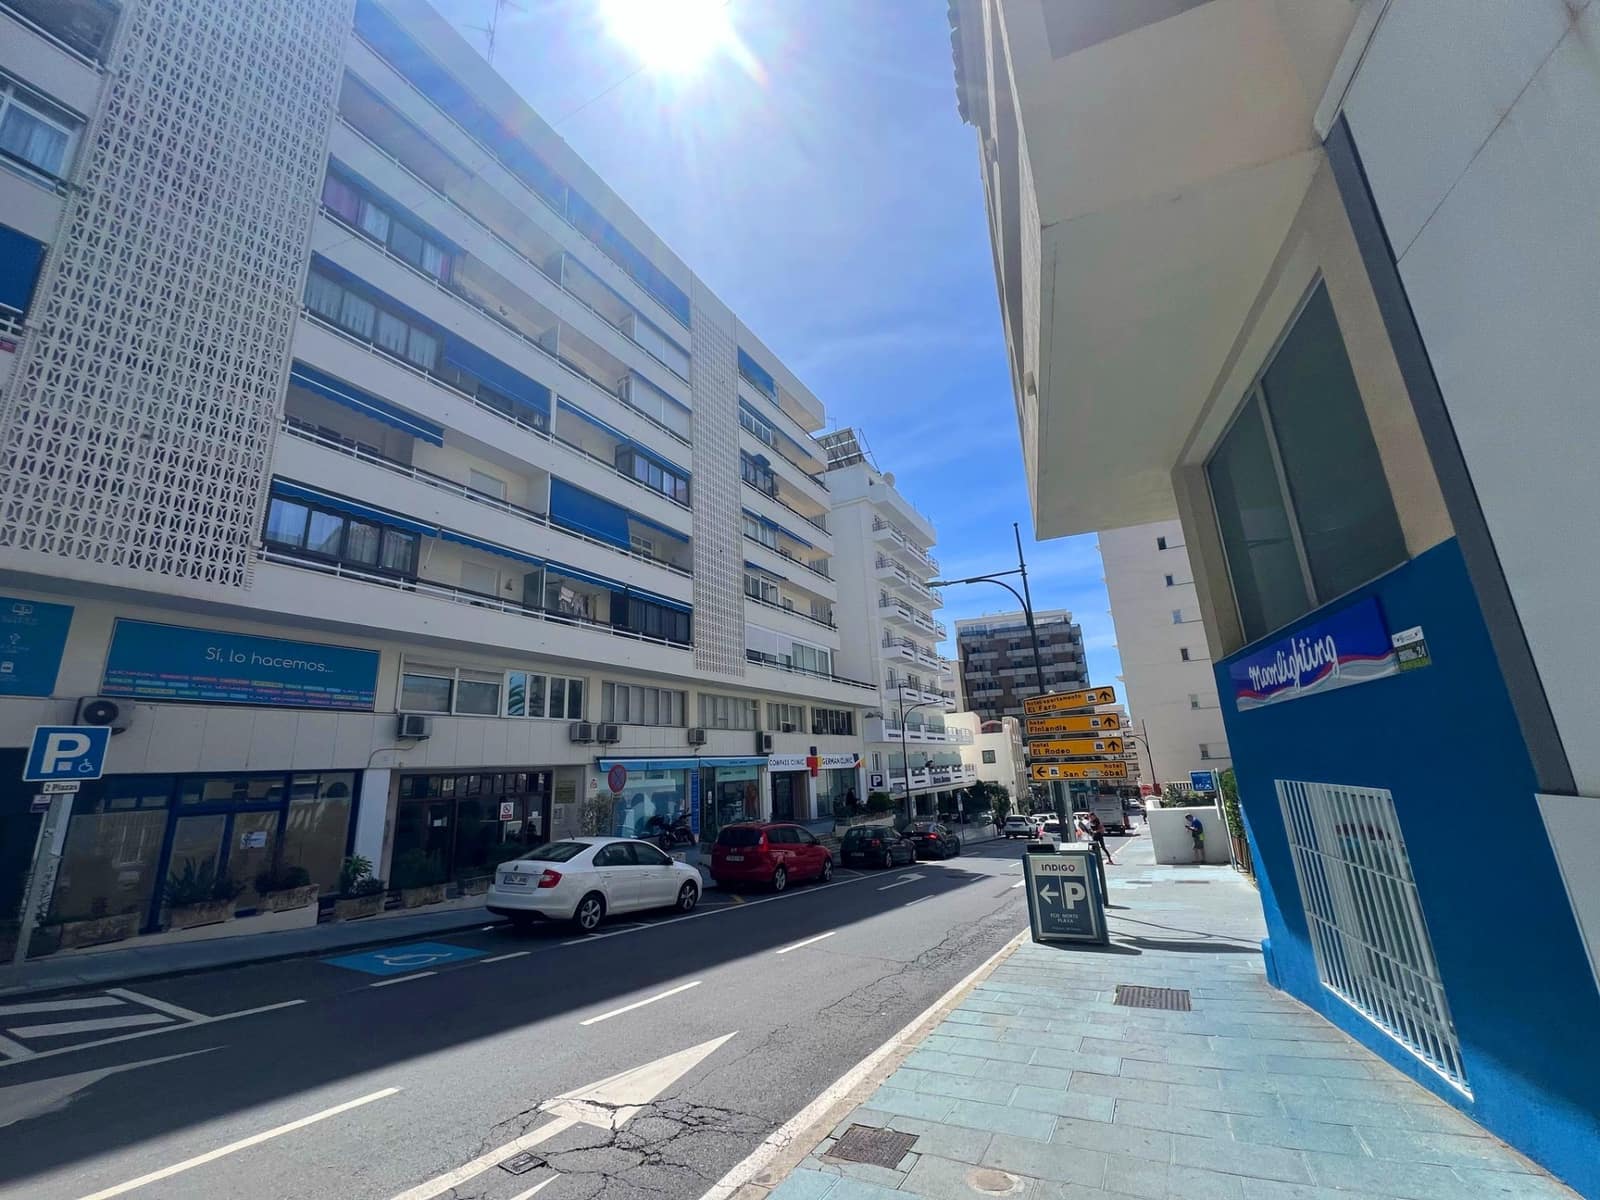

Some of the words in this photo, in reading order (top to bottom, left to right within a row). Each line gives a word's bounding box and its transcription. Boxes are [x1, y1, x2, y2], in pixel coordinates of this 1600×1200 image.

[205, 646, 225, 664] Sí,
[229, 648, 246, 664] lo
[1248, 634, 1339, 693] Moonlighting
[1039, 704, 1057, 712] Faro
[40, 733, 91, 774] P
[823, 756, 840, 764] GERMAN
[1083, 769, 1123, 777] Cóbal
[874, 776, 882, 785] P
[1041, 863, 1076, 872] INDIGO
[1064, 882, 1086, 909] P
